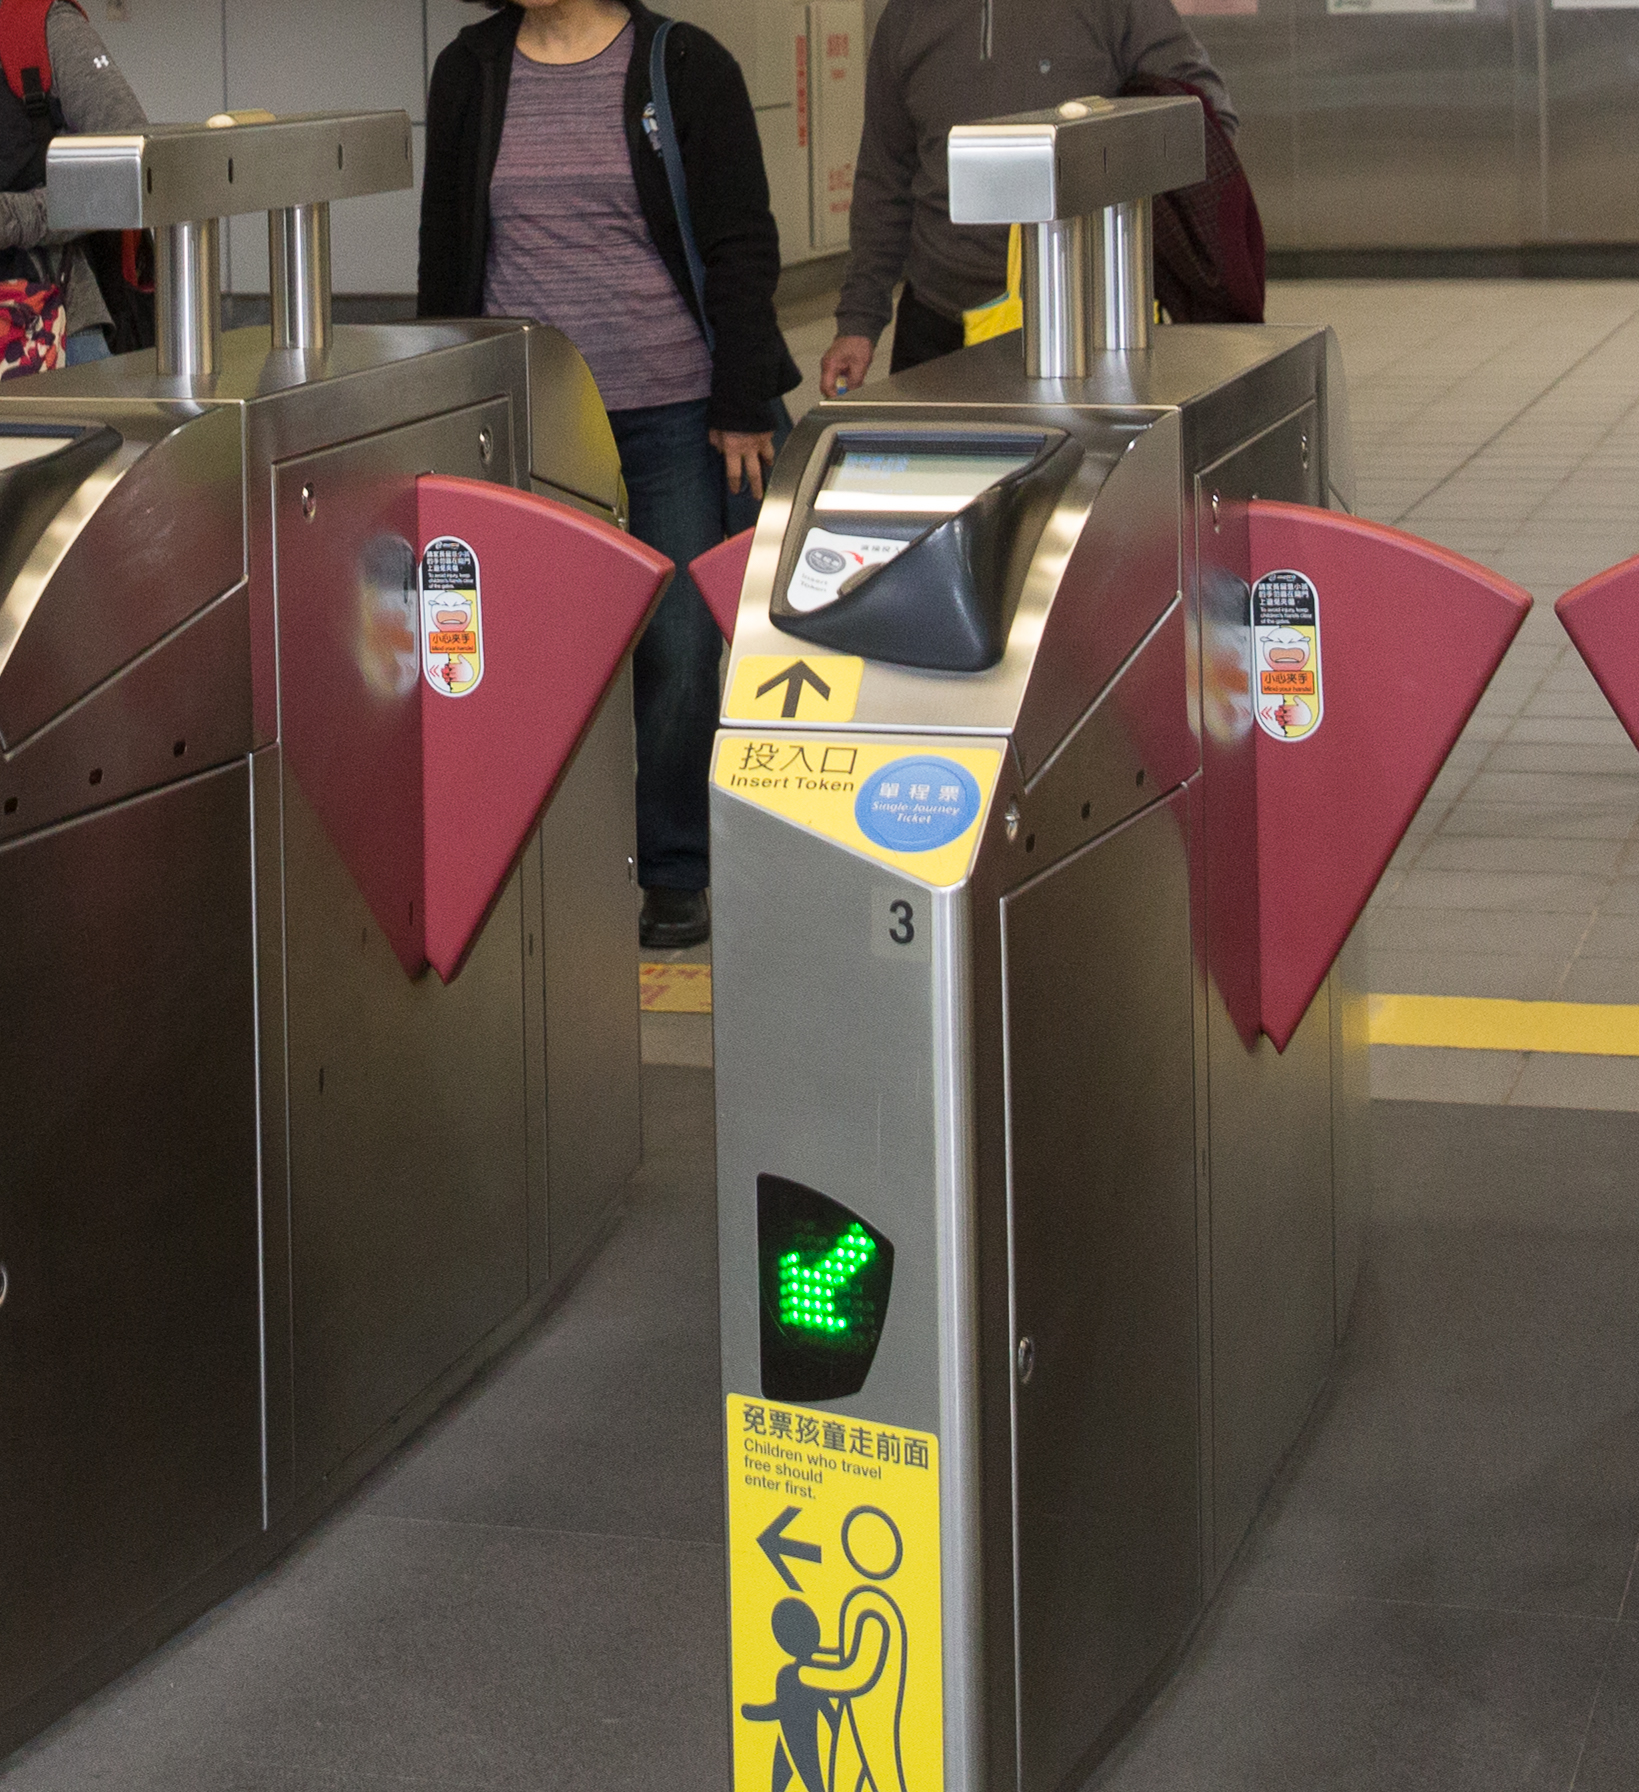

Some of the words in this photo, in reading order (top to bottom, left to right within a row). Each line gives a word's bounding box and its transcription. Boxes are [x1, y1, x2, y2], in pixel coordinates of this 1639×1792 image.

[432, 633, 471, 645] 小心夾手
[1265, 673, 1308, 684] 小心夾手
[739, 742, 858, 774] 投入口
[730, 774, 789, 788] Insert
[795, 776, 854, 792] Token
[879, 782, 959, 801] 單程票
[896, 812, 932, 824] Ticket
[889, 899, 914, 944] 3
[742, 1403, 929, 1470] 免票孩童走前面
[743, 1437, 803, 1463] Children
[807, 1451, 837, 1469] who
[841, 1458, 883, 1480] travel
[744, 1455, 772, 1473] free
[775, 1461, 823, 1484] should
[744, 1473, 781, 1492] enter
[784, 1478, 817, 1500] first.
